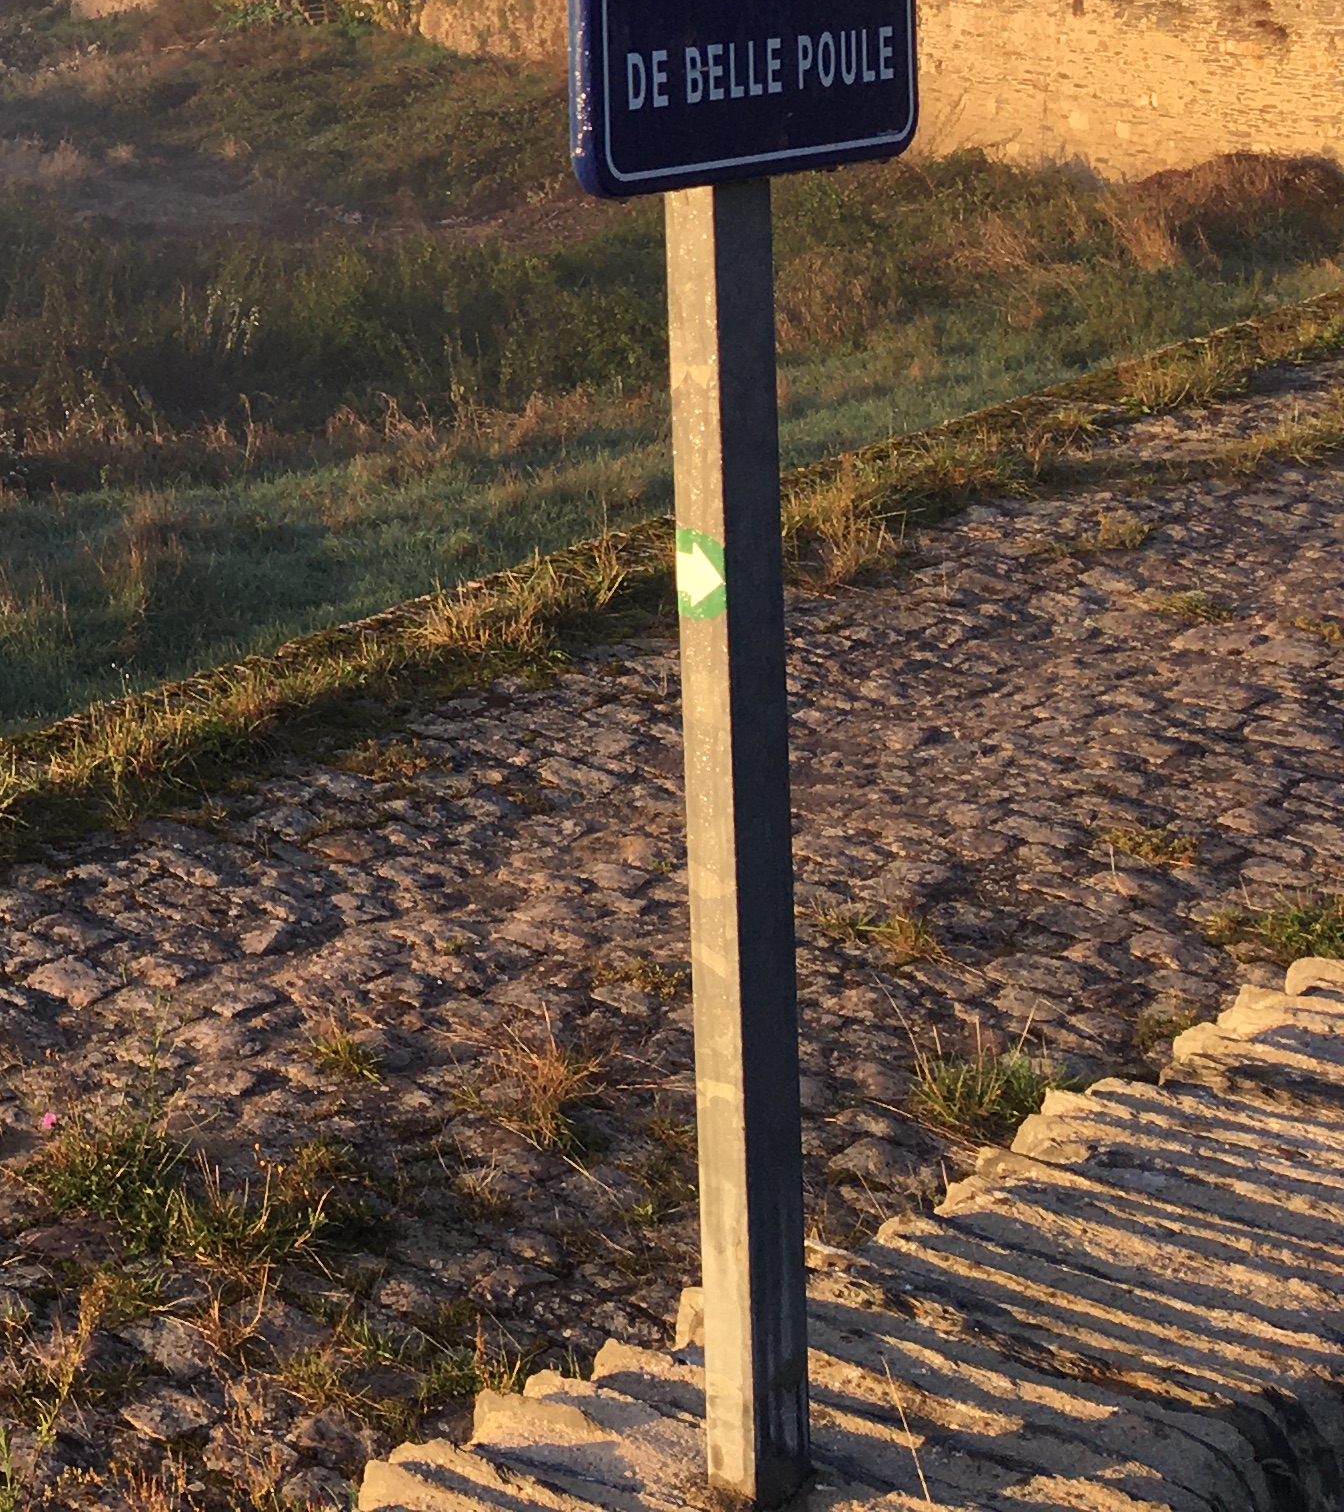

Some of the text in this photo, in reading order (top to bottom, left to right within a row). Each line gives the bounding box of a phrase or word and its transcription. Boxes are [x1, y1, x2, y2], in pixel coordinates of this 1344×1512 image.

[627, 25, 895, 111] DE BELLE POULE
